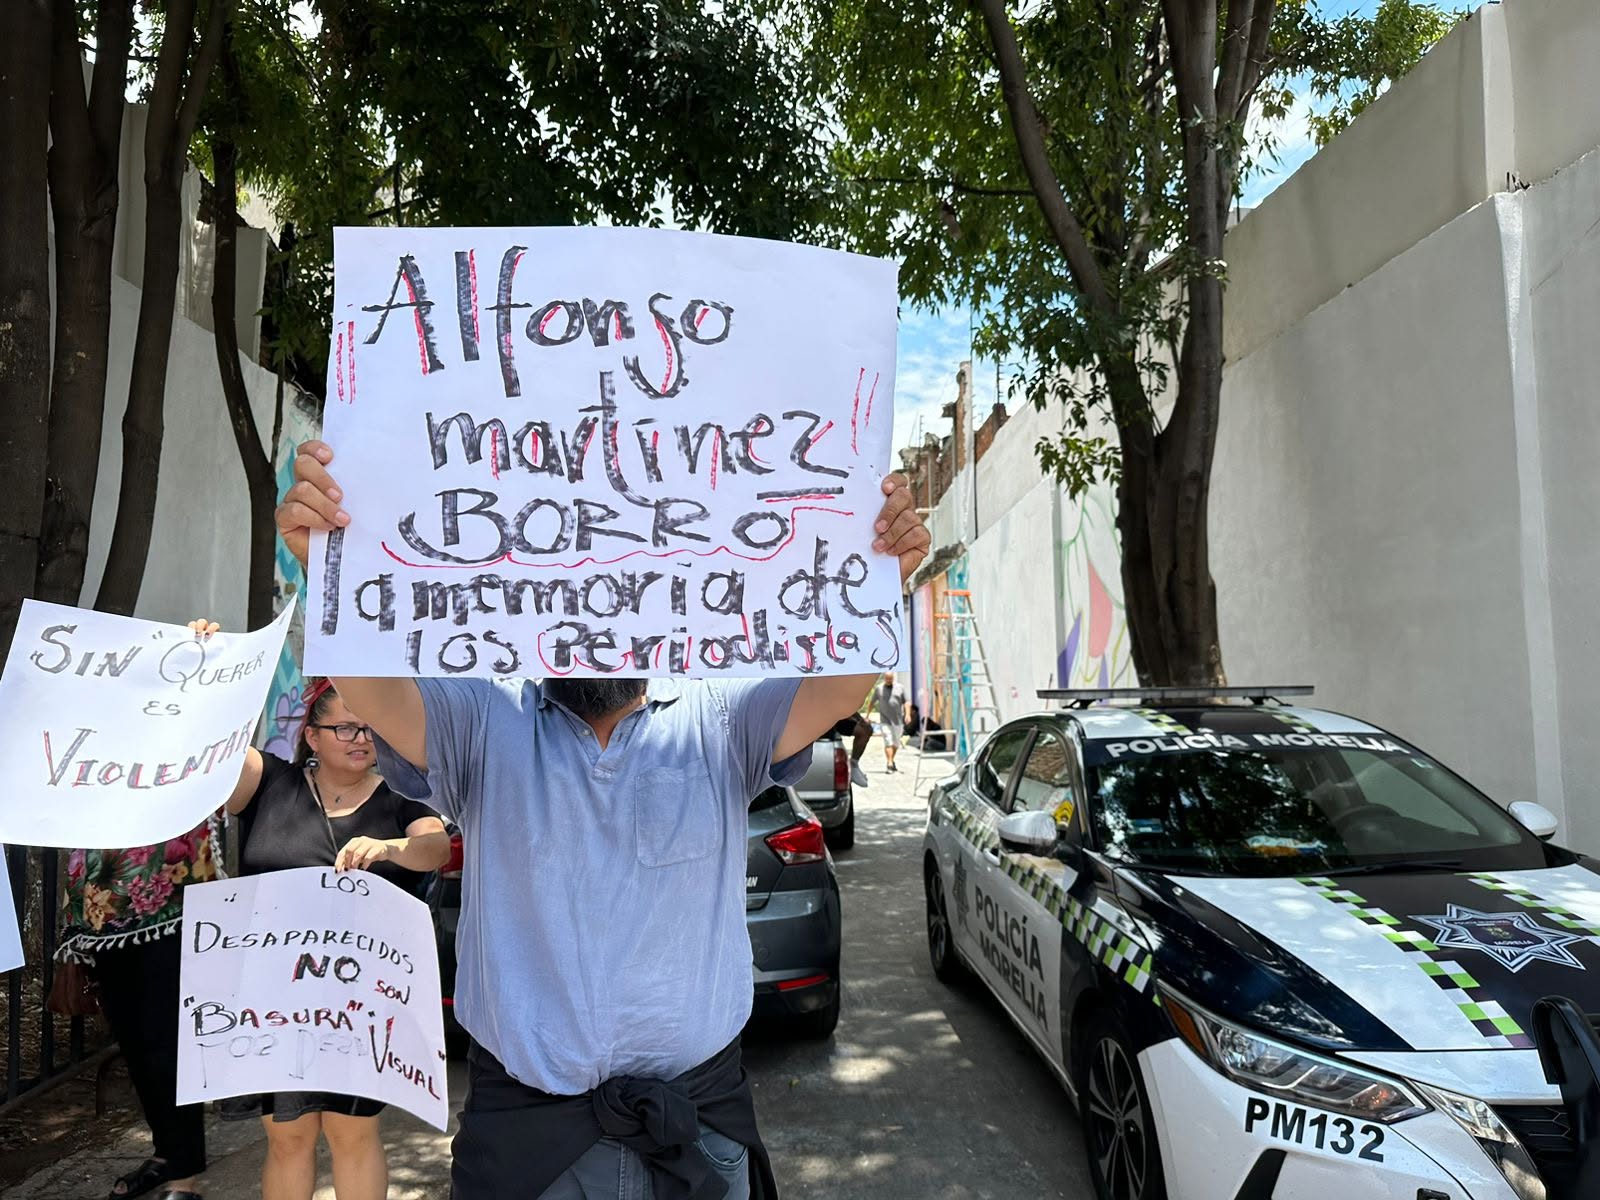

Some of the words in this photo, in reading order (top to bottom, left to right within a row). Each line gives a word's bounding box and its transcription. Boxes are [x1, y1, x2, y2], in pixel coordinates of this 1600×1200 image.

[398, 488, 788, 563] BORRO
[321, 527, 396, 636] la
[411, 562, 745, 628] memoria
[777, 535, 893, 621] de
[405, 629, 521, 675] los
[1105, 728, 1249, 758] POLICÍA
[1252, 733, 1411, 754] MORELIA
[320, 872, 370, 897] LOS
[975, 885, 1044, 982] POLICÍA
[292, 952, 361, 984] NO
[980, 930, 1049, 1032] MORELIA
[1245, 1097, 1385, 1163] PM132
